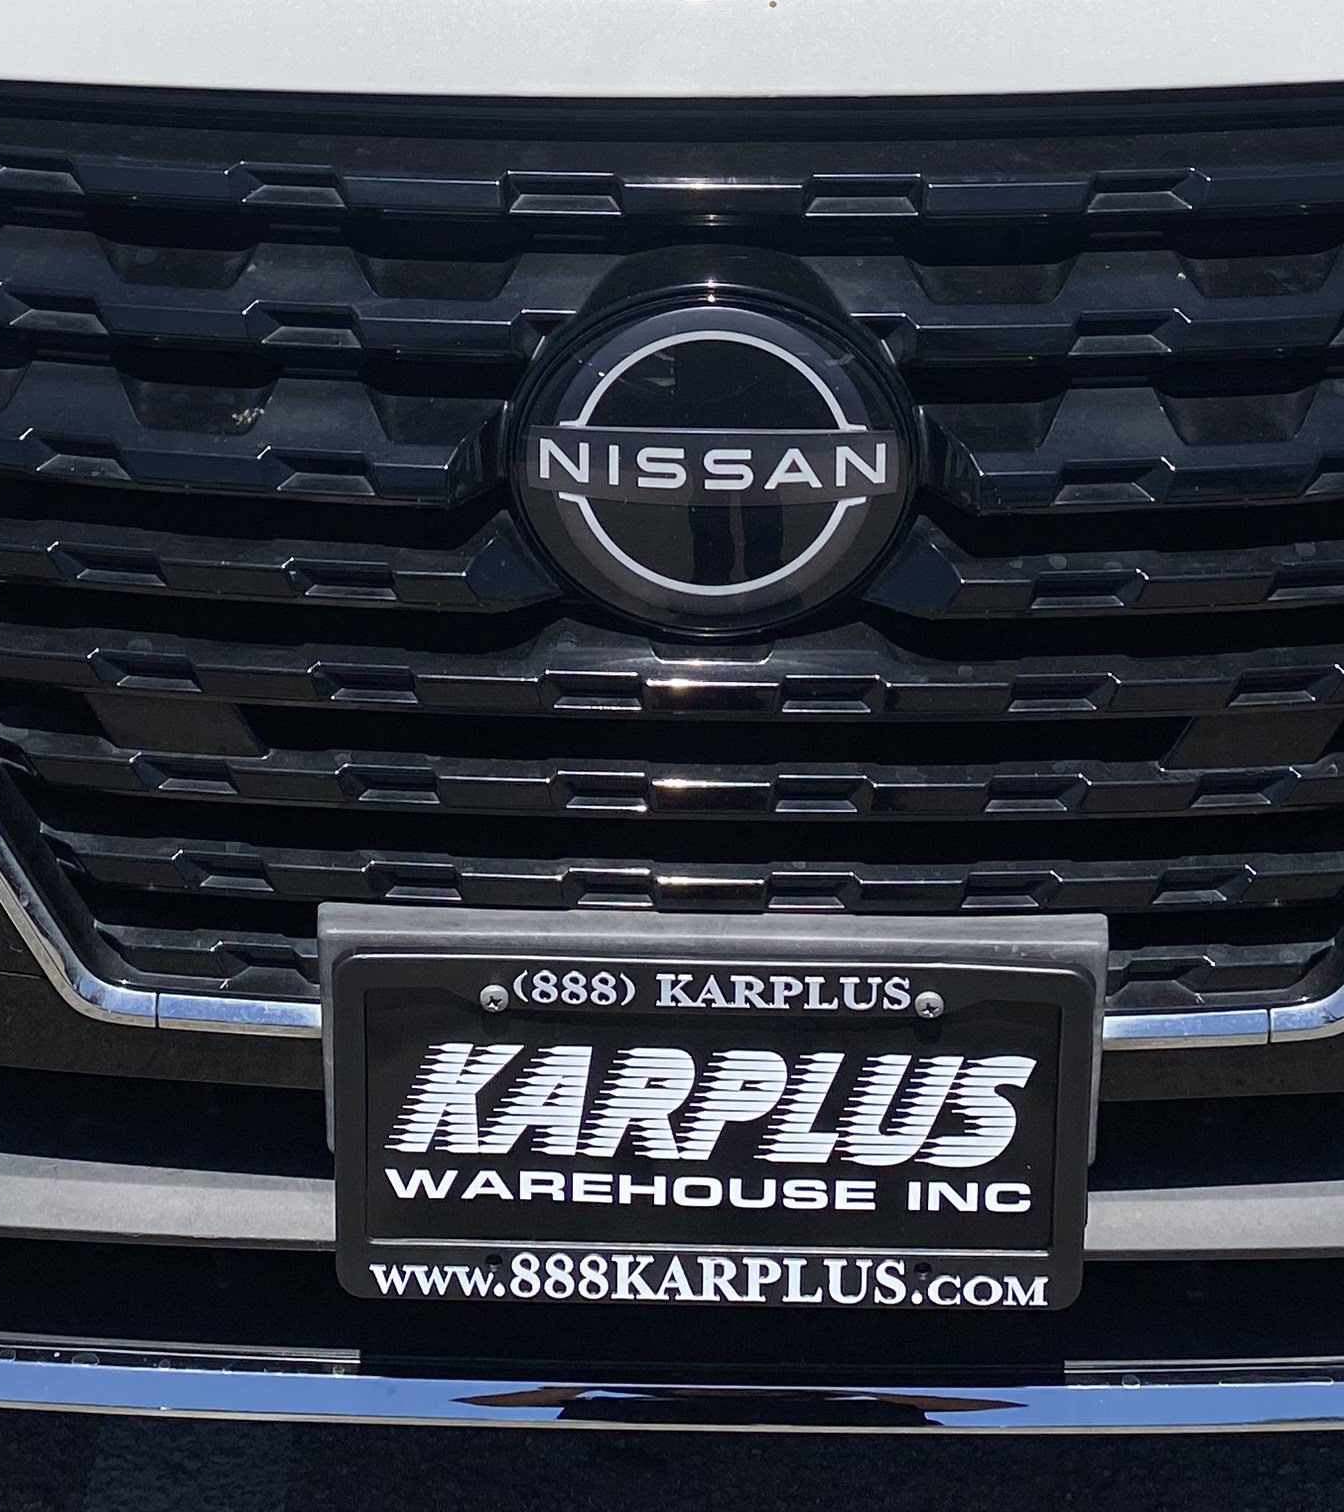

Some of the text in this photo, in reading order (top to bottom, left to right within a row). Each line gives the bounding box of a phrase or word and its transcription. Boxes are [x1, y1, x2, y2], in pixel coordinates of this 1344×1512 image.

[538, 437, 887, 491] NISSAN
[512, 968, 912, 1013] (888) KARPLUS
[383, 1041, 1037, 1169] KARPLUS
[384, 1168, 1032, 1214] WAREHOUSE INC
